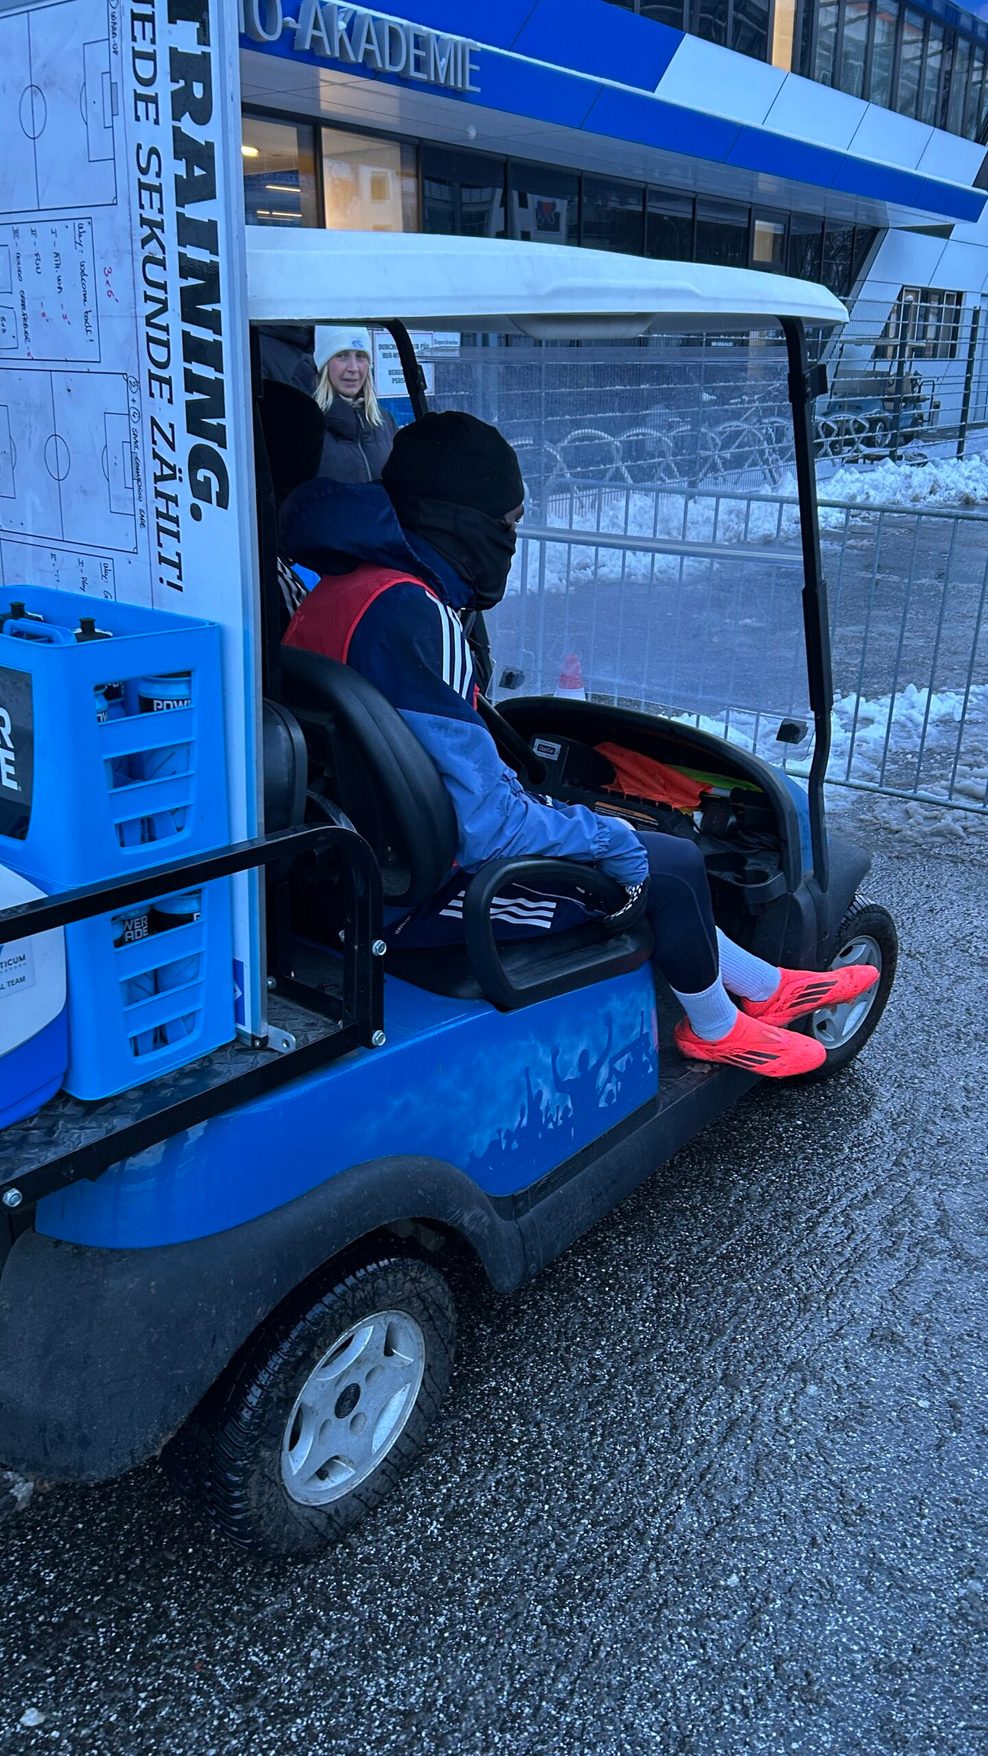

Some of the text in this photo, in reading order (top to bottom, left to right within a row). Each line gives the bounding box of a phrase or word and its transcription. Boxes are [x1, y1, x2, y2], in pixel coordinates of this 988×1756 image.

[239, 0, 481, 92] O-AKADEMIE
[136, 142, 174, 405] SEKUNDE
[167, 0, 230, 522] TRAINING.
[150, 415, 184, 593] ZÄHLT!
